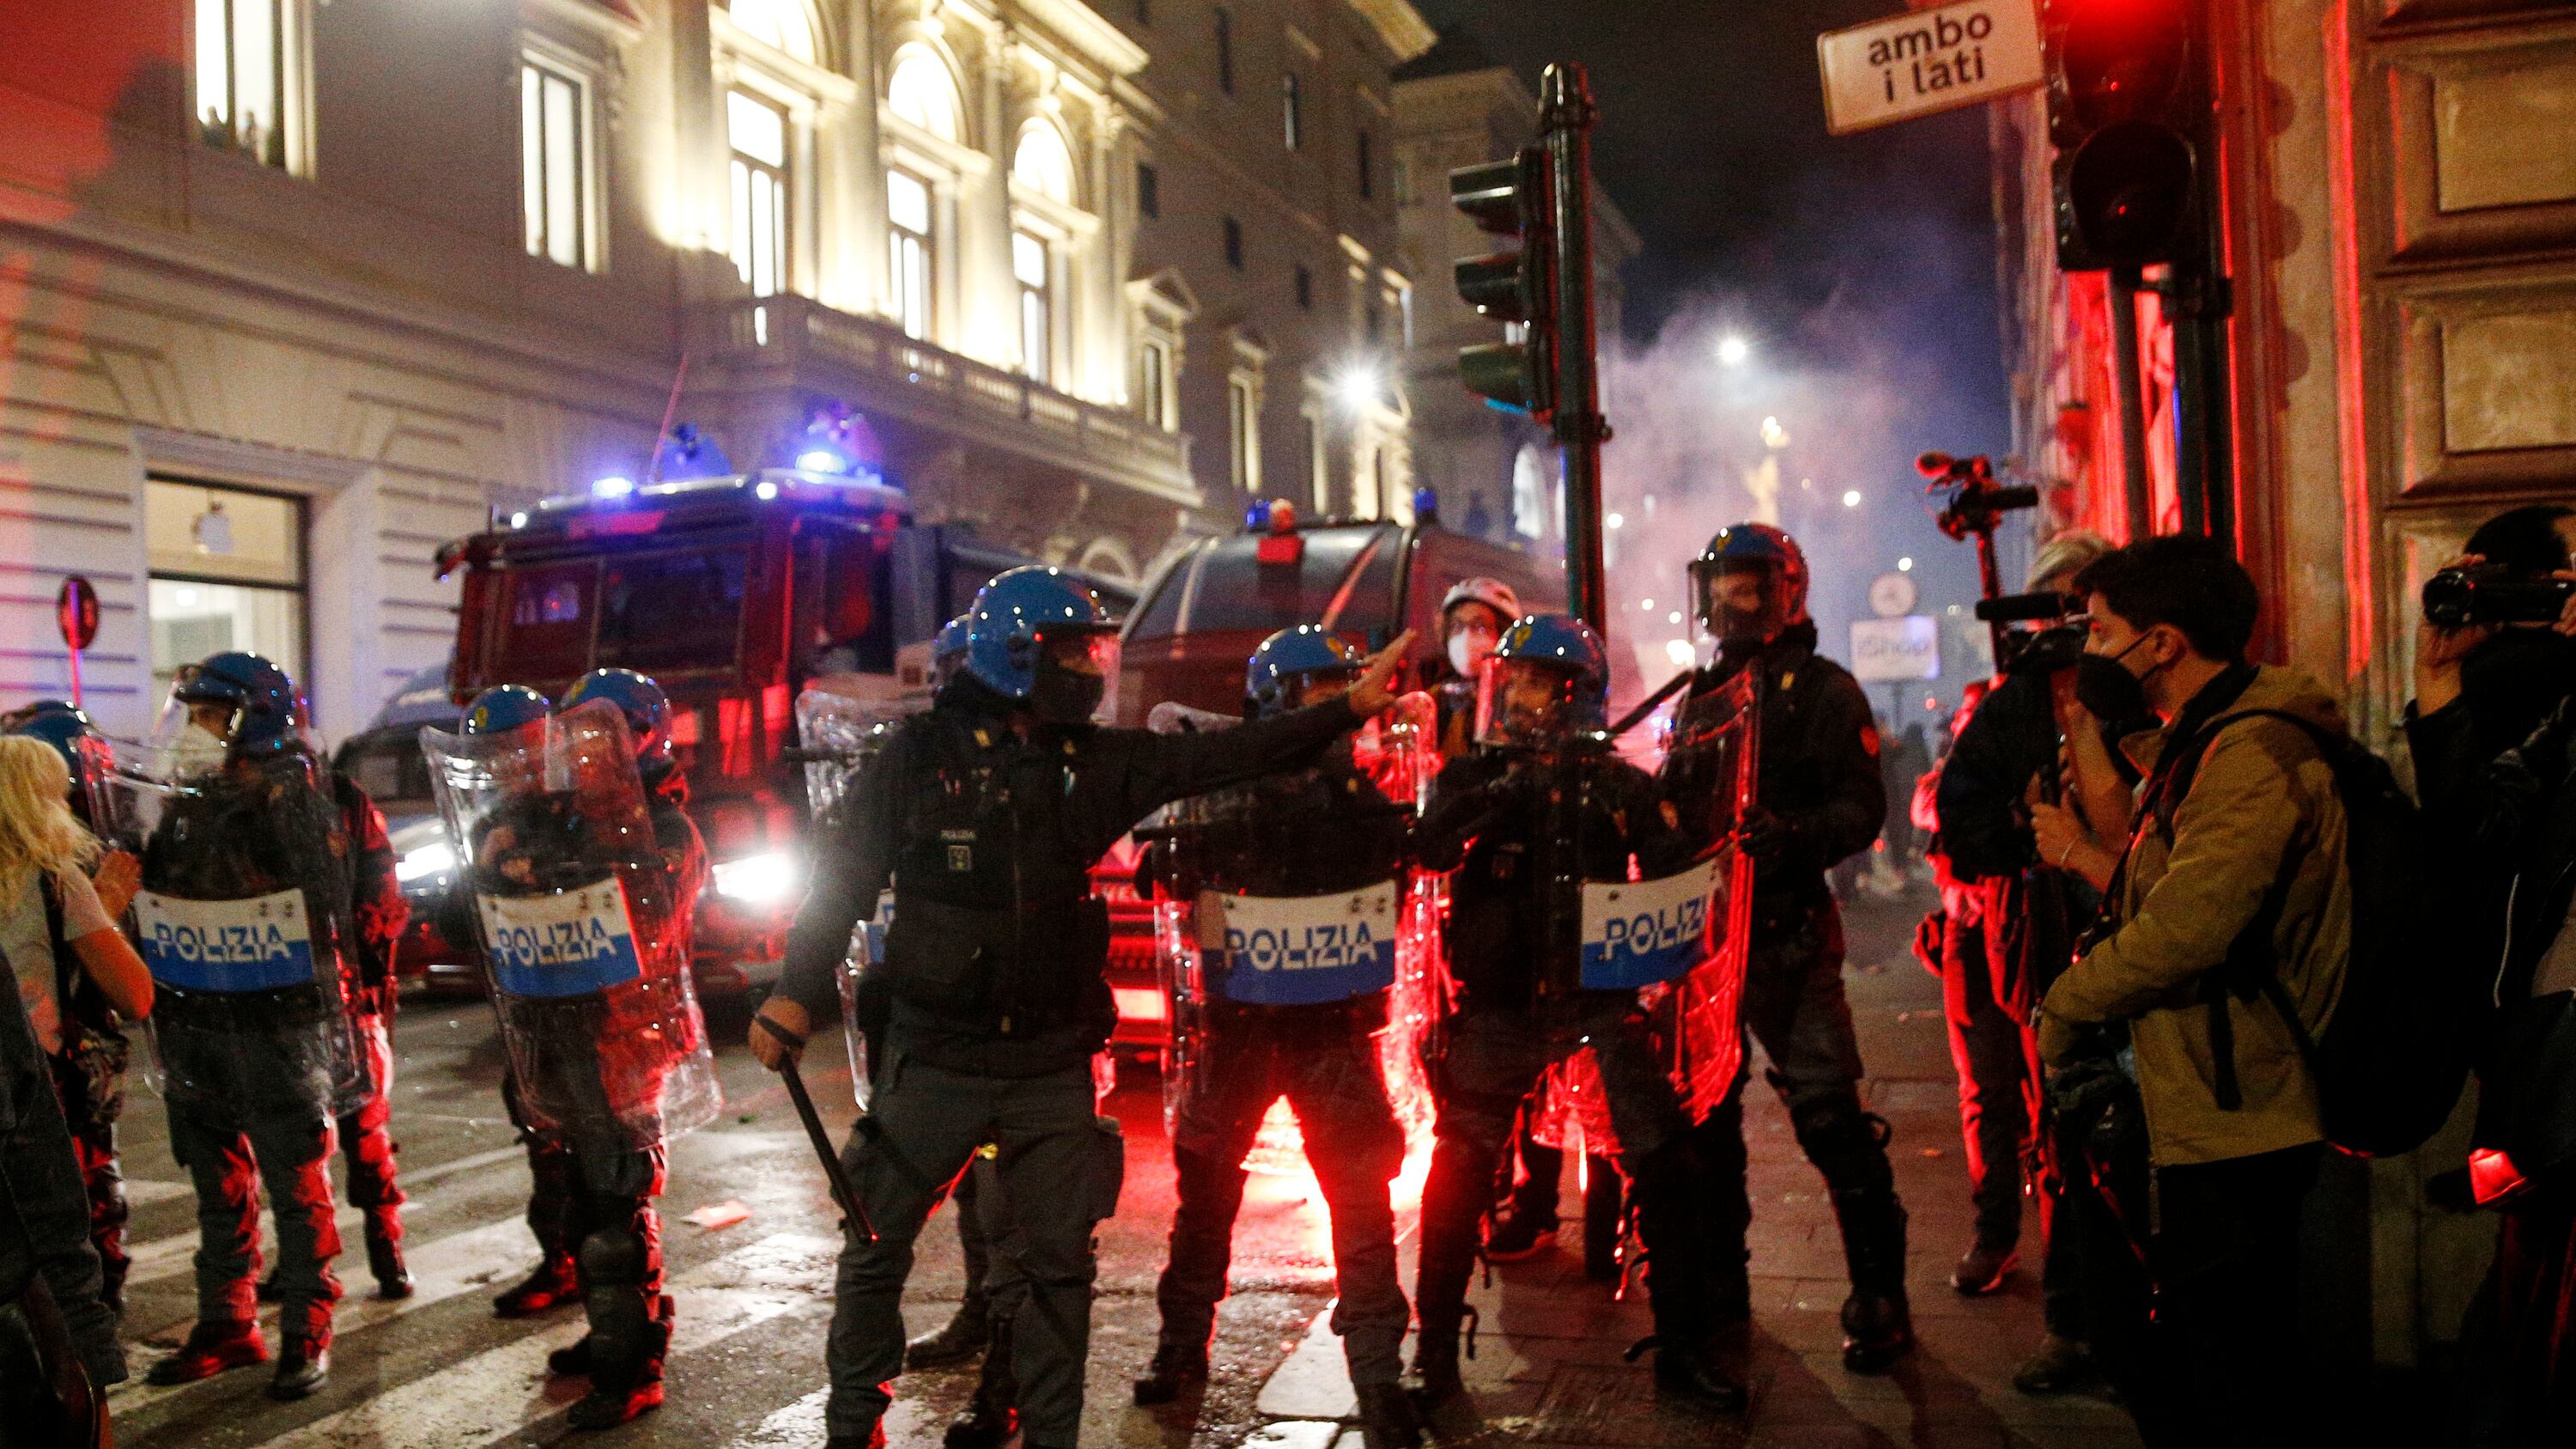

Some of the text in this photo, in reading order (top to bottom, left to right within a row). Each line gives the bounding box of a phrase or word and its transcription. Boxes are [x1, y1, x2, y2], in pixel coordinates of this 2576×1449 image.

[1868, 12, 1992, 66] ambo
[1884, 46, 1984, 102] i lati
[155, 922, 292, 963] POLIZIA
[496, 916, 617, 967] POLIZIA
[1224, 921, 1378, 971] POLIZIA
[1605, 894, 1707, 956] POLIZI
